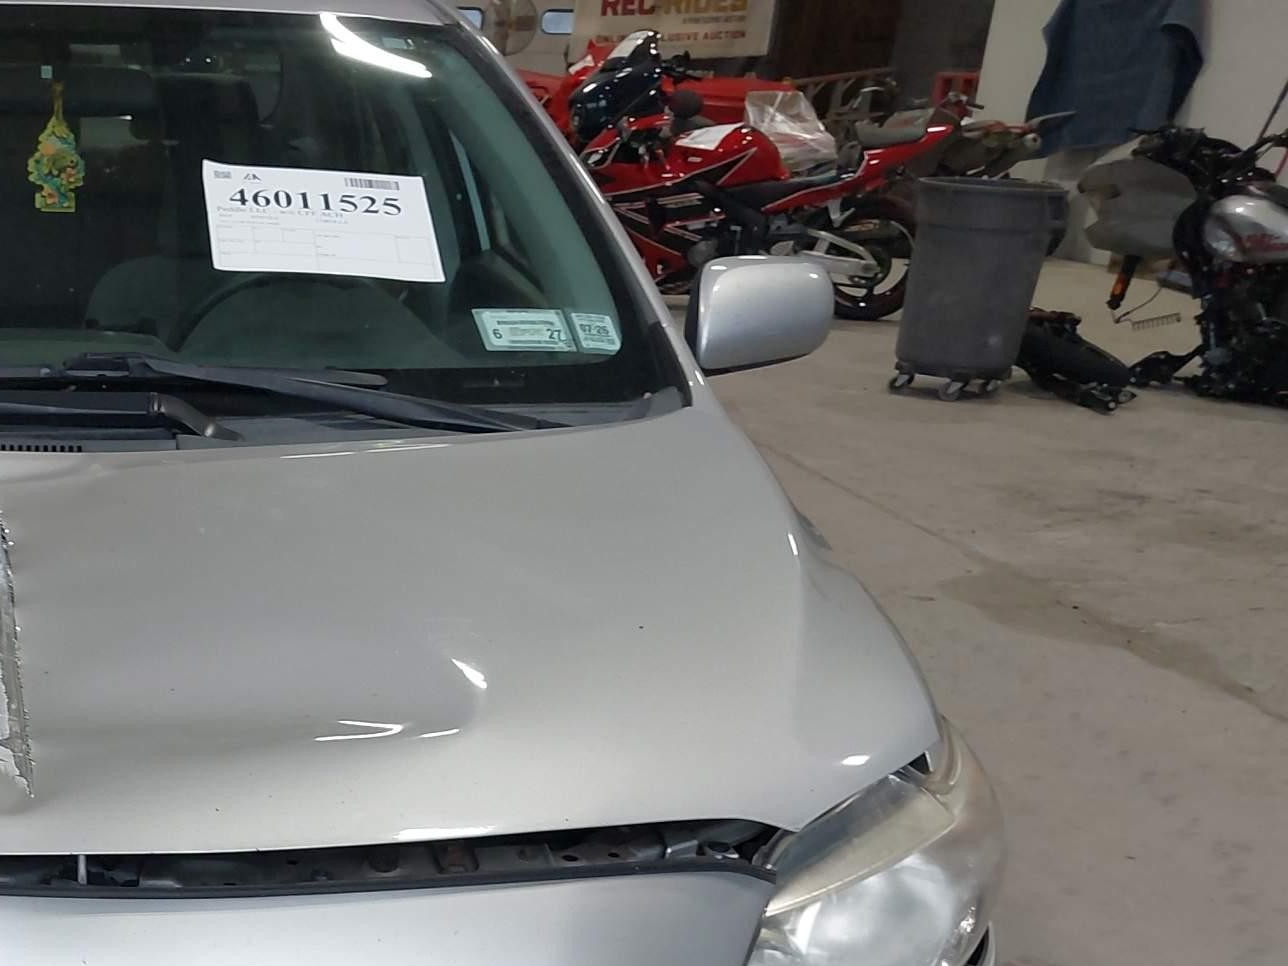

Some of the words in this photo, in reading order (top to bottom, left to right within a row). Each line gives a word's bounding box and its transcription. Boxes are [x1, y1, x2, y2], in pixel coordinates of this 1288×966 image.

[702, 30, 746, 41] AUCTION
[229, 187, 402, 216] 46011525
[492, 328, 503, 340] 6
